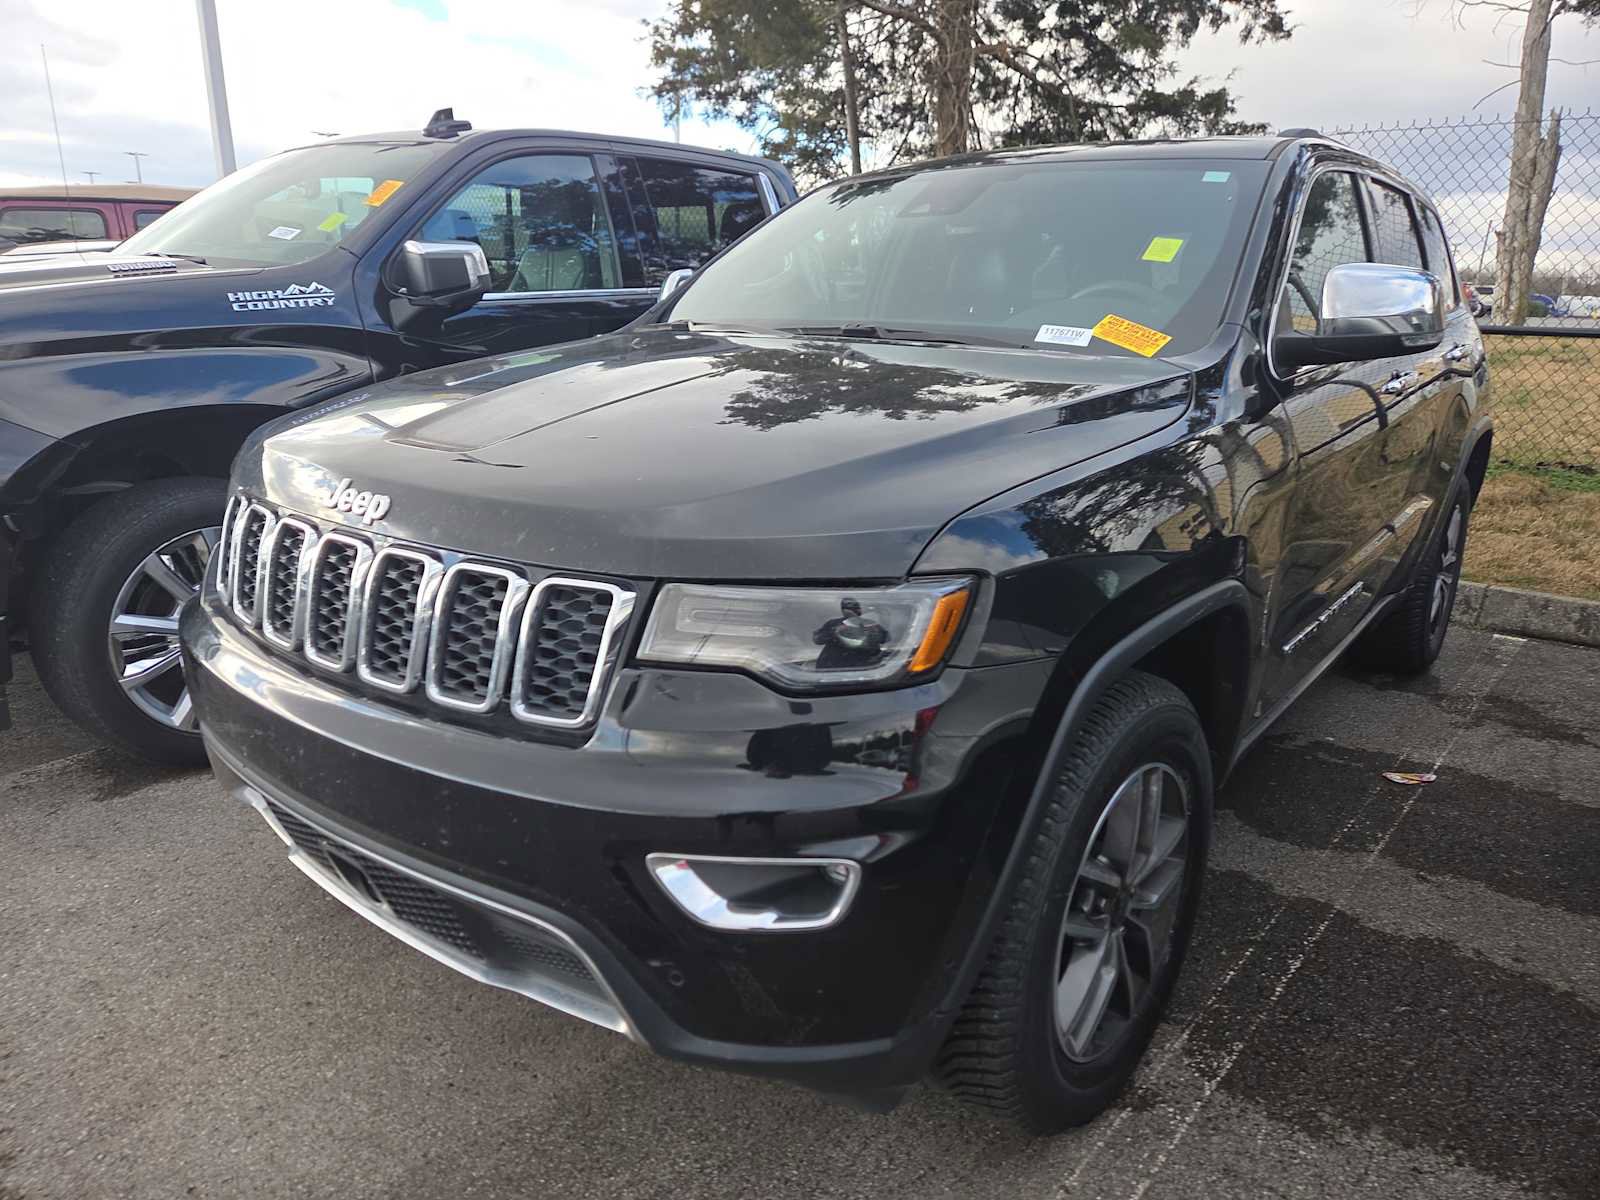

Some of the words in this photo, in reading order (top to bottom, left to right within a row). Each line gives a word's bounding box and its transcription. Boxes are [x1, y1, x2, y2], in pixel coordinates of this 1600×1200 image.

[227, 290, 283, 302] HIGH
[232, 297, 335, 312] COUNTRY
[323, 478, 391, 526] Jeep
